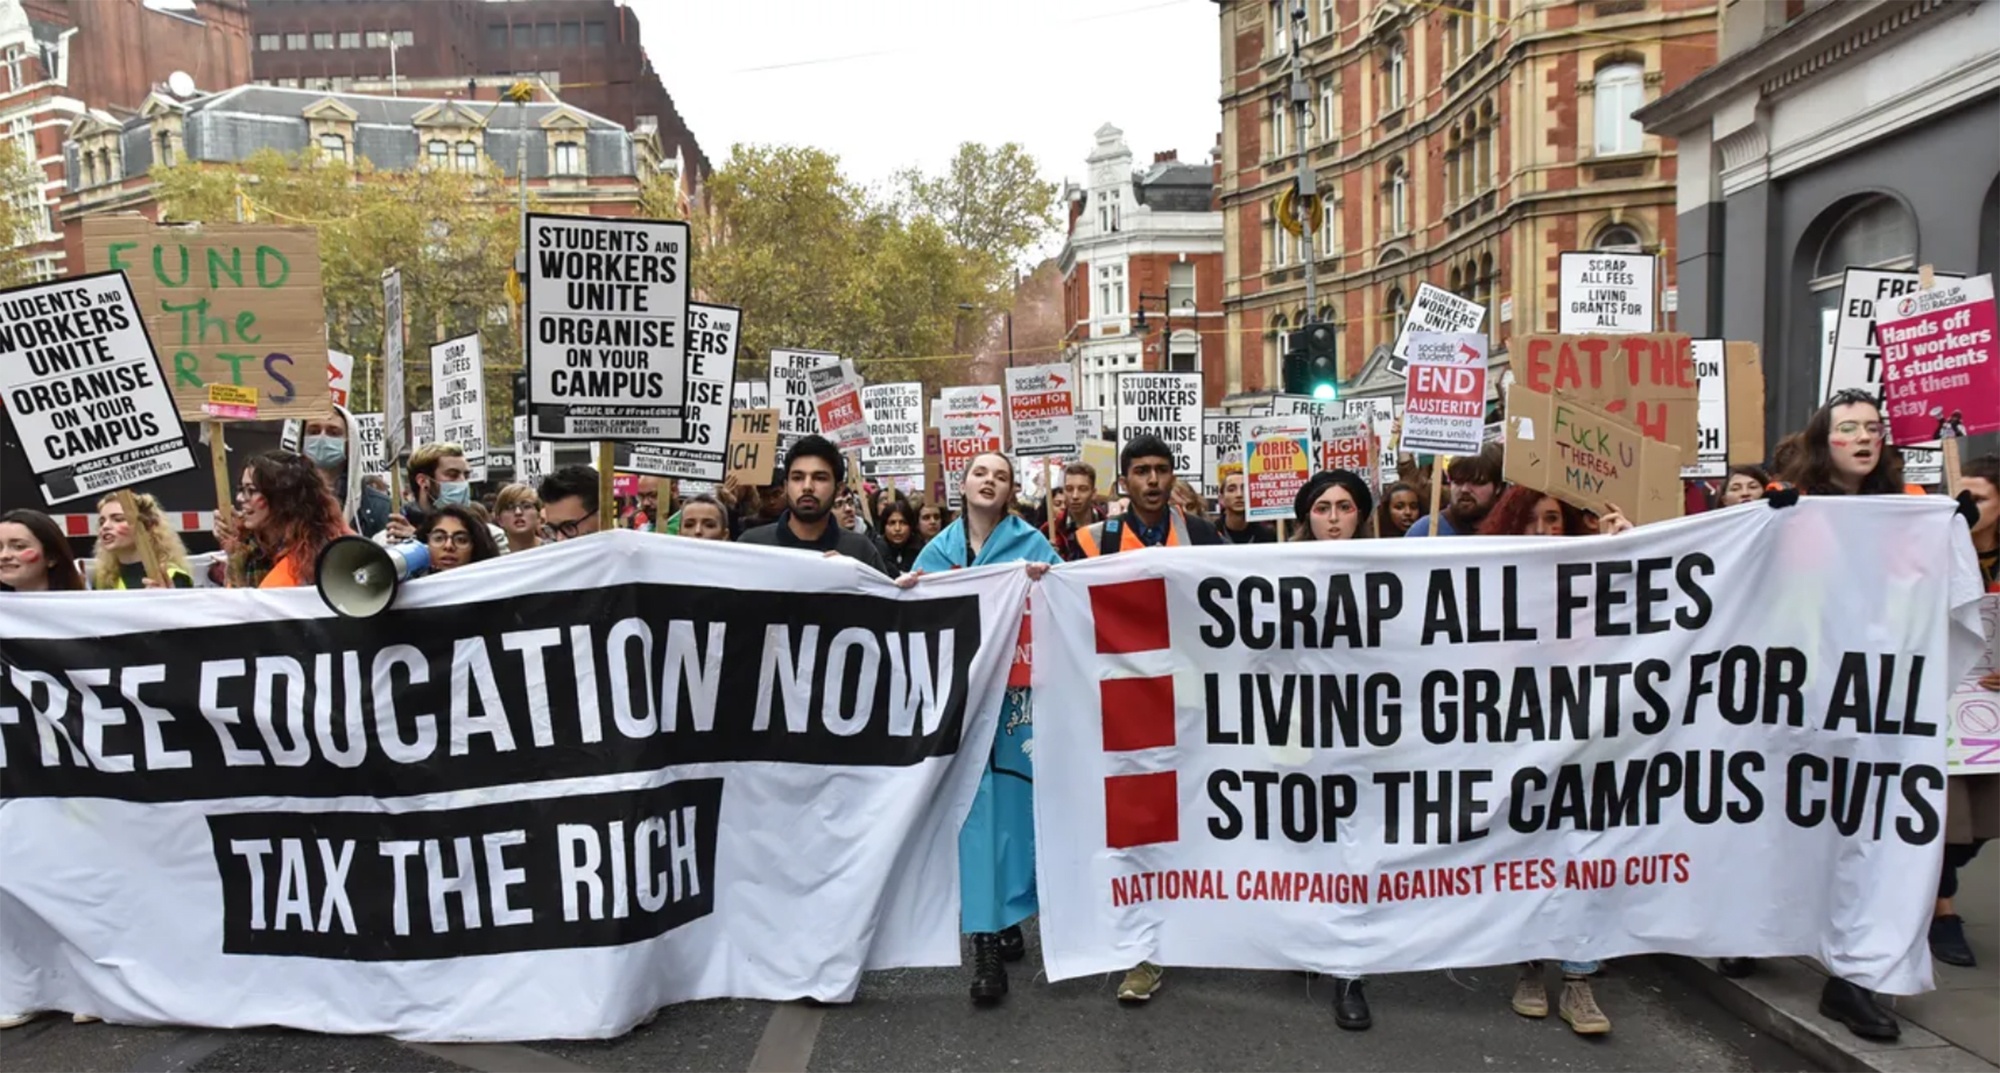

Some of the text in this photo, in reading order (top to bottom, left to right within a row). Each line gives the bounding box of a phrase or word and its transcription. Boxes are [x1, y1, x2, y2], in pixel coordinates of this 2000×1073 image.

[538, 226, 678, 254] STUDENTS AND
[108, 242, 290, 289] FUND
[539, 250, 676, 284] WORKERS
[1589, 260, 1627, 271] SCRAP
[1581, 272, 1634, 285] ALL FEES
[1877, 278, 1919, 300] FRE
[98, 291, 122, 304] AND
[568, 282, 648, 312] UNITE
[1422, 287, 1468, 311] STUDENTS
[1588, 289, 1627, 302] LIVING
[1918, 287, 1961, 302] STAND UP
[1919, 294, 1967, 312] TO RACISM
[1418, 296, 1476, 328] WORKERS
[1571, 302, 1642, 315] GRANTS FOR
[161, 297, 262, 345] The
[713, 321, 731, 332] AND
[1424, 312, 1460, 332] UNITE
[1596, 315, 1618, 326] ALL
[1882, 309, 1971, 345] Hands off
[539, 317, 675, 348] ORGANISE
[26, 336, 115, 376] UNITE
[1417, 352, 1455, 361] students
[1418, 343, 1454, 352] socialist
[1885, 329, 1992, 364] EU workers
[566, 348, 649, 369] ON YOUR
[1527, 338, 1609, 394] EAT
[1620, 336, 1697, 389] THE
[1887, 349, 1988, 382] & students
[12, 362, 153, 415] ORGANISE
[173, 352, 296, 405] RTS
[551, 370, 663, 398] CAMPUS
[786, 380, 808, 395] NO
[1122, 377, 1181, 389] STUDENTS
[1417, 367, 1476, 394] END
[1889, 372, 1970, 399] Let them
[865, 387, 906, 398] STUDENTS
[865, 396, 918, 409] WORKERS
[1013, 393, 1066, 406] FIGHT FOR
[1123, 390, 1197, 406] WORKERS
[51, 396, 136, 430] ON YOUR
[874, 408, 907, 420] UNITE
[1013, 406, 1068, 419] SOCIALISM
[1138, 406, 1182, 422] UNITE
[1293, 401, 1325, 415] FREE
[1408, 398, 1481, 415] AUSTERITY
[1893, 400, 1928, 418] stay
[741, 413, 771, 433] THE
[779, 418, 819, 433] HE RIC
[1218, 421, 1241, 434] FRE
[1409, 415, 1473, 427] Students and
[44, 412, 160, 460] CAMPUS
[1408, 427, 1443, 437] workers
[1555, 406, 1610, 457] FUCK
[1619, 441, 1633, 468] U
[727, 443, 758, 470] ICH
[869, 445, 915, 457] CAMPUS
[1255, 440, 1300, 457] TORIES
[1263, 456, 1293, 471] OUT!
[1327, 454, 1360, 470] FEES
[1556, 441, 1618, 479] THERESA
[83, 459, 158, 483] NATIONAL CAMPAIGN
[86, 462, 173, 491] AGAINST FEES AND CUTS
[1566, 466, 1604, 494] MAY
[1198, 552, 1715, 650] SCRAP ALL FEES
[200, 616, 726, 769] EDUCATION
[754, 623, 955, 737] NOW
[1204, 644, 1937, 749] LIVING GRANTS FOR ALL
[1206, 749, 1945, 846] STOP THE CAMPUS CUTS
[230, 805, 701, 936] TAX THE RICH
[1111, 851, 1690, 908] NATIONAL CAMPAIGN AGAINST FEES AND CUTS
